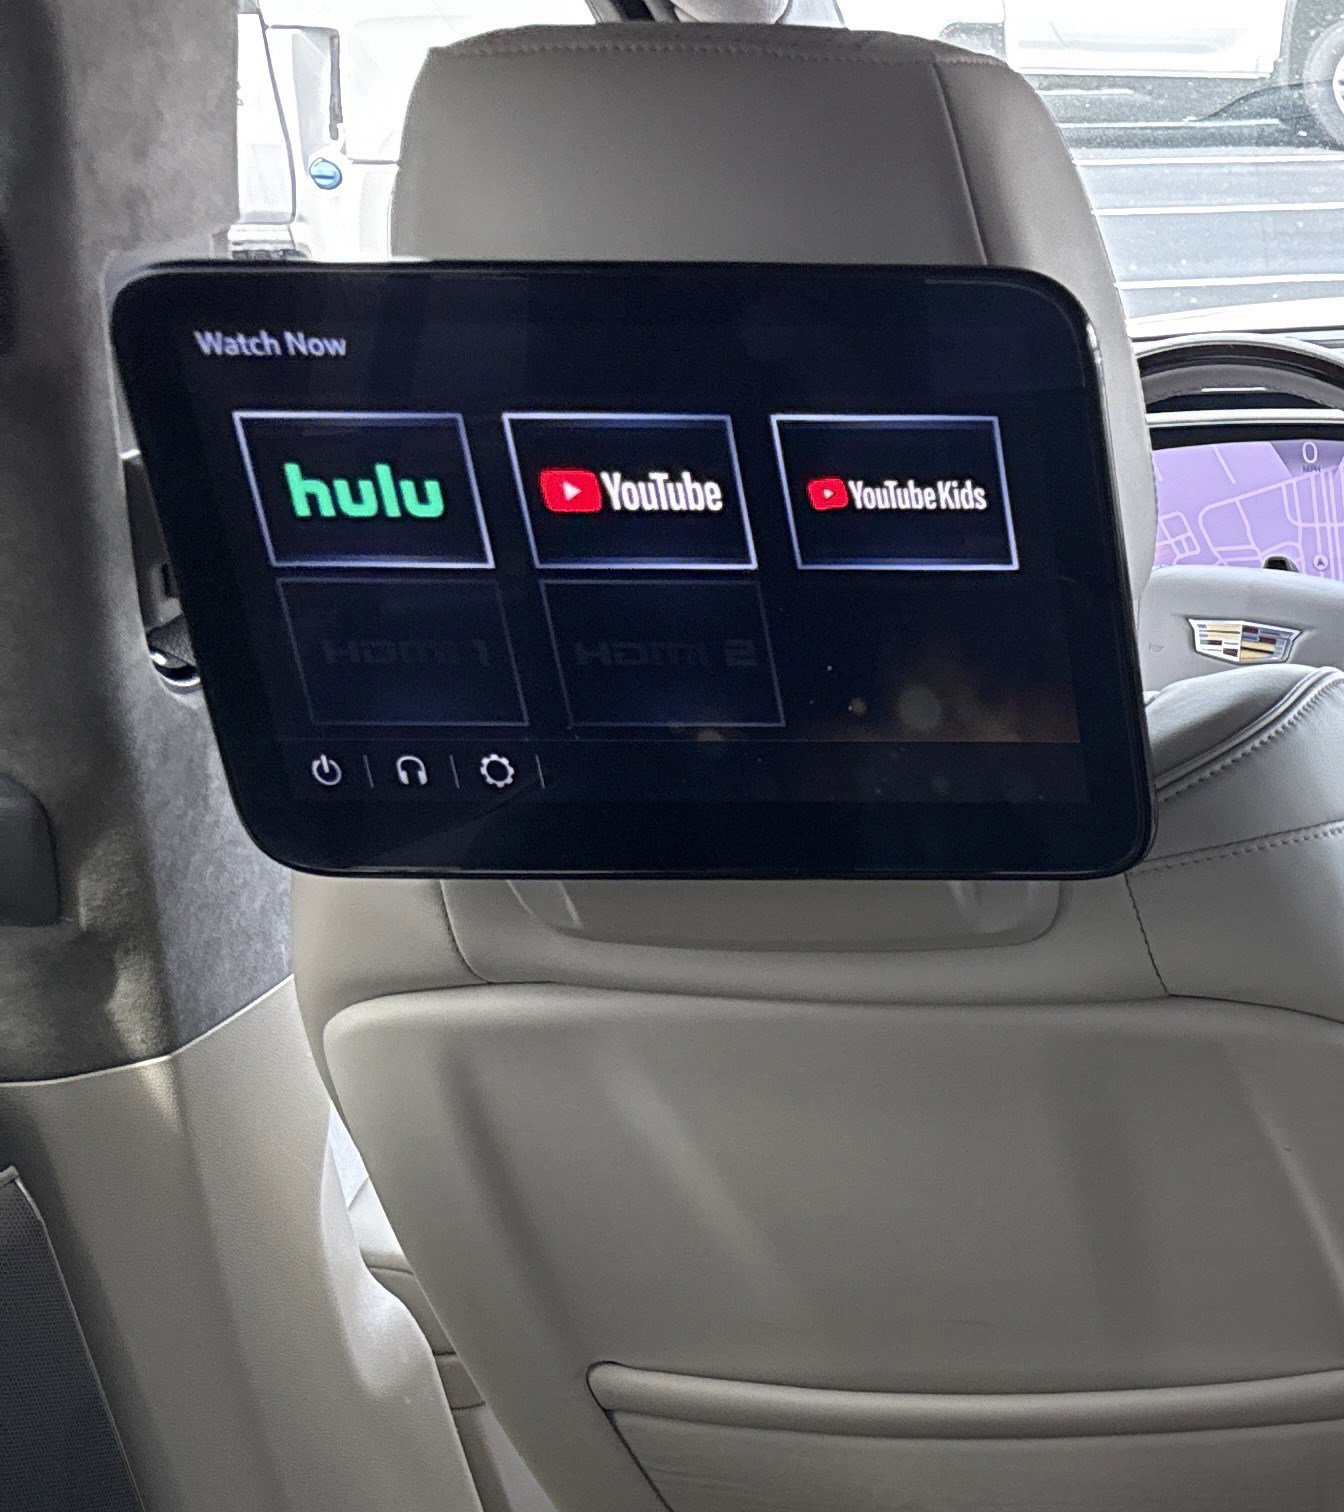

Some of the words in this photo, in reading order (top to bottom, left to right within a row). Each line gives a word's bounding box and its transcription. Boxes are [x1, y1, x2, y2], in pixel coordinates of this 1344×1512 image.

[194, 329, 281, 357] Watch
[283, 330, 347, 357] Now
[1302, 441, 1318, 464] 0
[284, 462, 445, 518] hulu
[602, 472, 724, 513] YouTube
[848, 479, 937, 510] YouTube
[936, 479, 988, 510] Kids
[323, 638, 459, 665] HDMI
[575, 639, 708, 668] HDMI
[724, 638, 757, 668] 2
